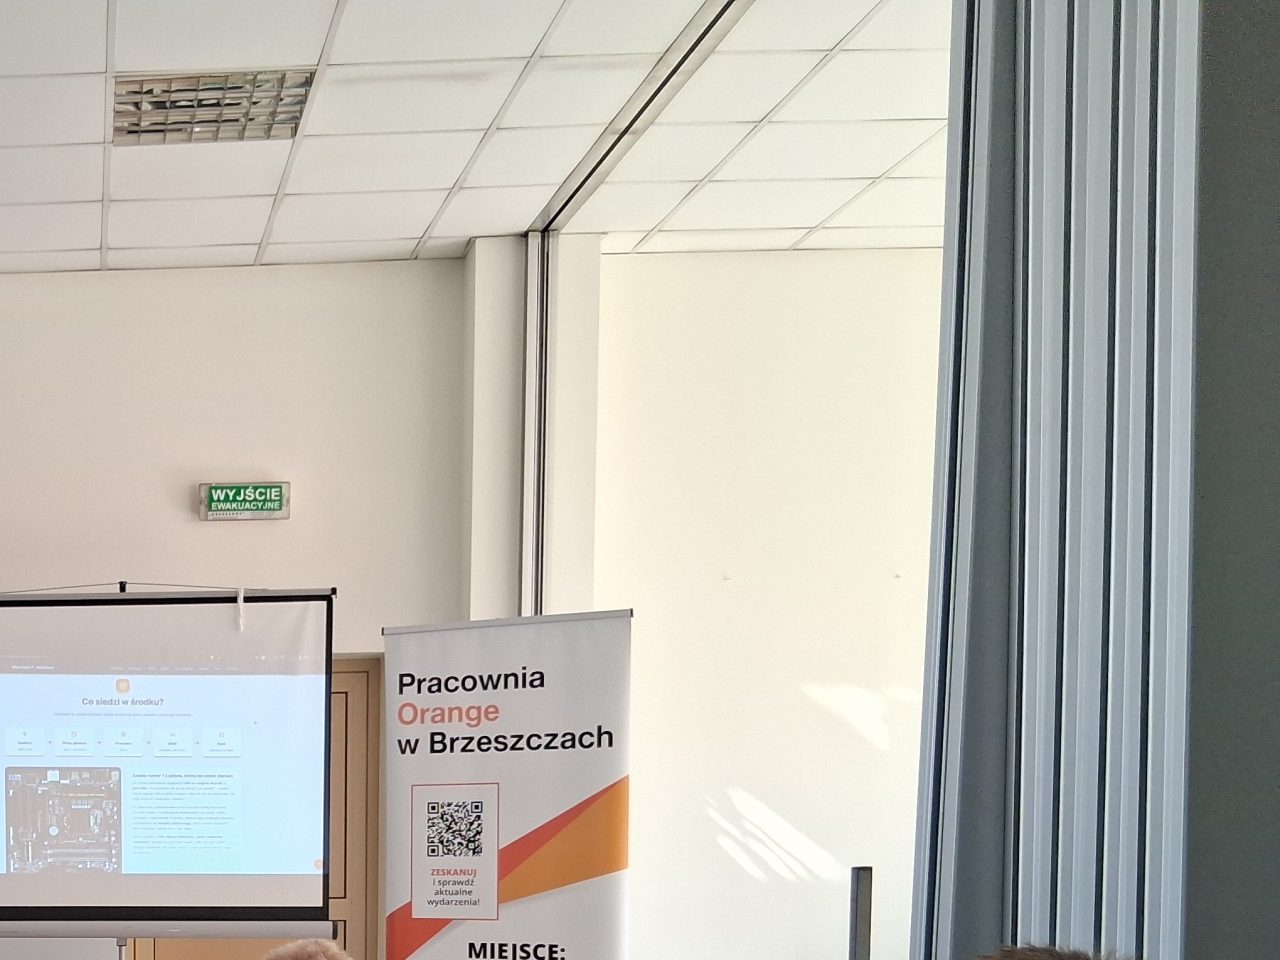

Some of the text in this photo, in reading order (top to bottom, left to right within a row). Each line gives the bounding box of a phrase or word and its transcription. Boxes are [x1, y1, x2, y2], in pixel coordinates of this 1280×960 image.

[211, 487, 281, 501] WYJŚCIE
[211, 501, 280, 510] EWAKUACYJNE
[398, 667, 545, 695] Pracownia
[82, 698, 94, 706] Co
[397, 702, 500, 727] Orange
[397, 726, 614, 755] w Brzeszczach
[430, 868, 477, 877] ZESKANUJ
[437, 878, 474, 888] sprawdź
[426, 898, 480, 907] wydarzenia!
